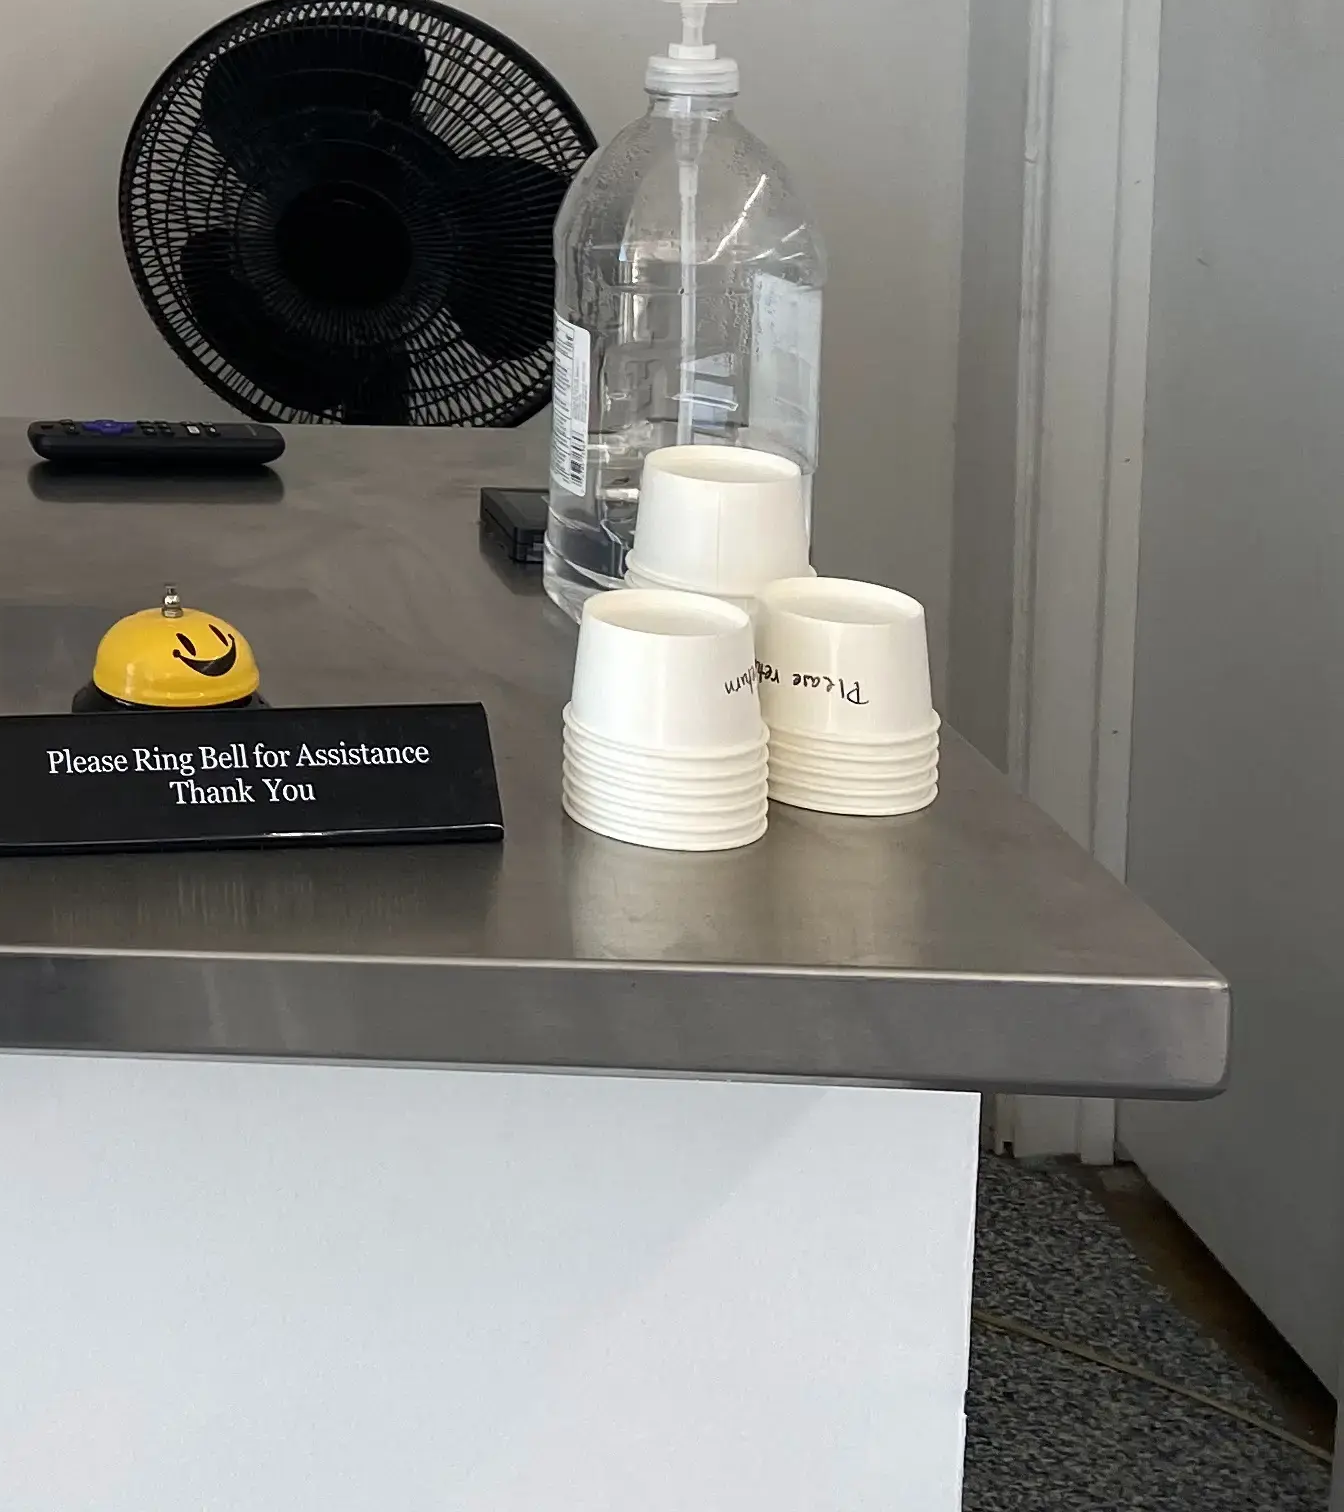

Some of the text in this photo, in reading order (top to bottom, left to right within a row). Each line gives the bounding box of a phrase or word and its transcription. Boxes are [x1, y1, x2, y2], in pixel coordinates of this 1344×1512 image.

[46, 741, 429, 776] Please Ring Bell for Assistance
[170, 780, 315, 805] Thank You
